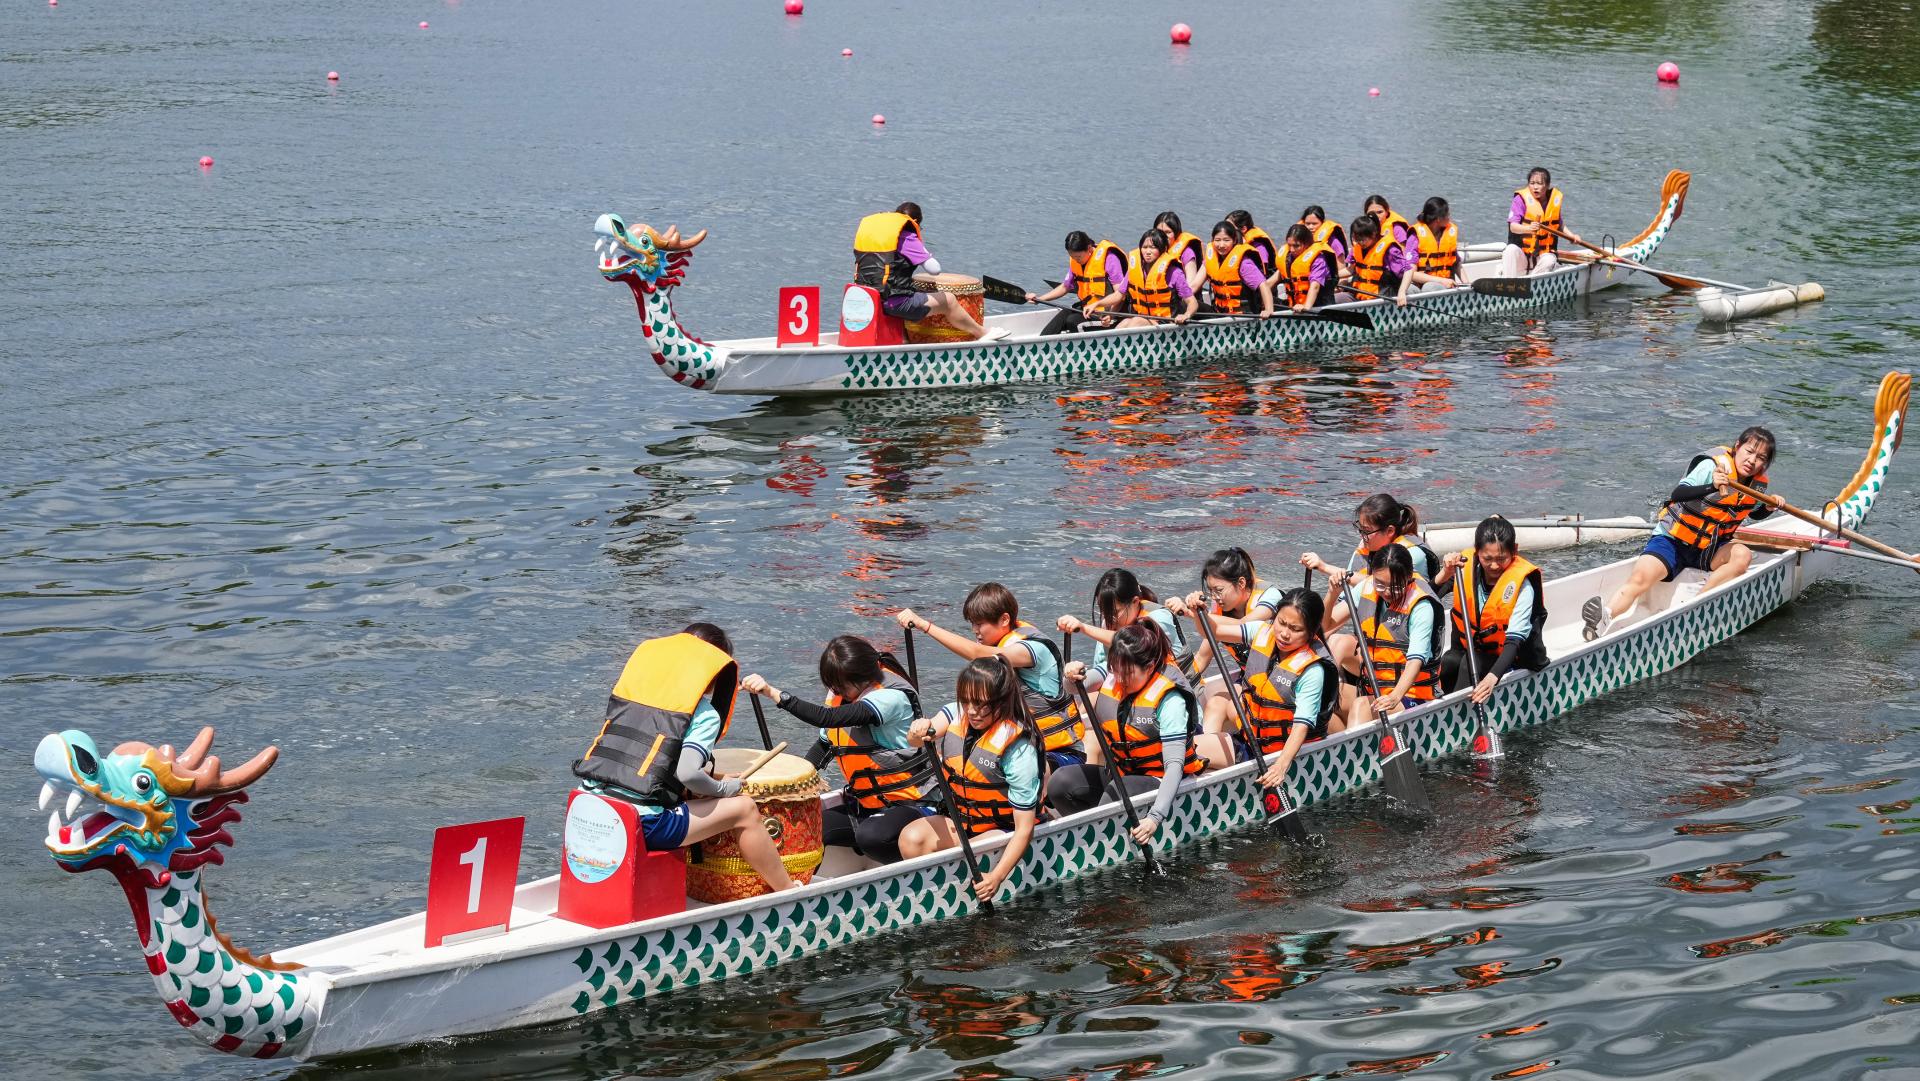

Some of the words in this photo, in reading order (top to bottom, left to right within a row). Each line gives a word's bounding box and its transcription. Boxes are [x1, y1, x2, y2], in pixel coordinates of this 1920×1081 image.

[788, 294, 809, 336] 3
[1276, 675, 1292, 687] SOB
[1136, 716, 1154, 725] SOB
[978, 757, 996, 769] SOB
[459, 836, 488, 914] 1
